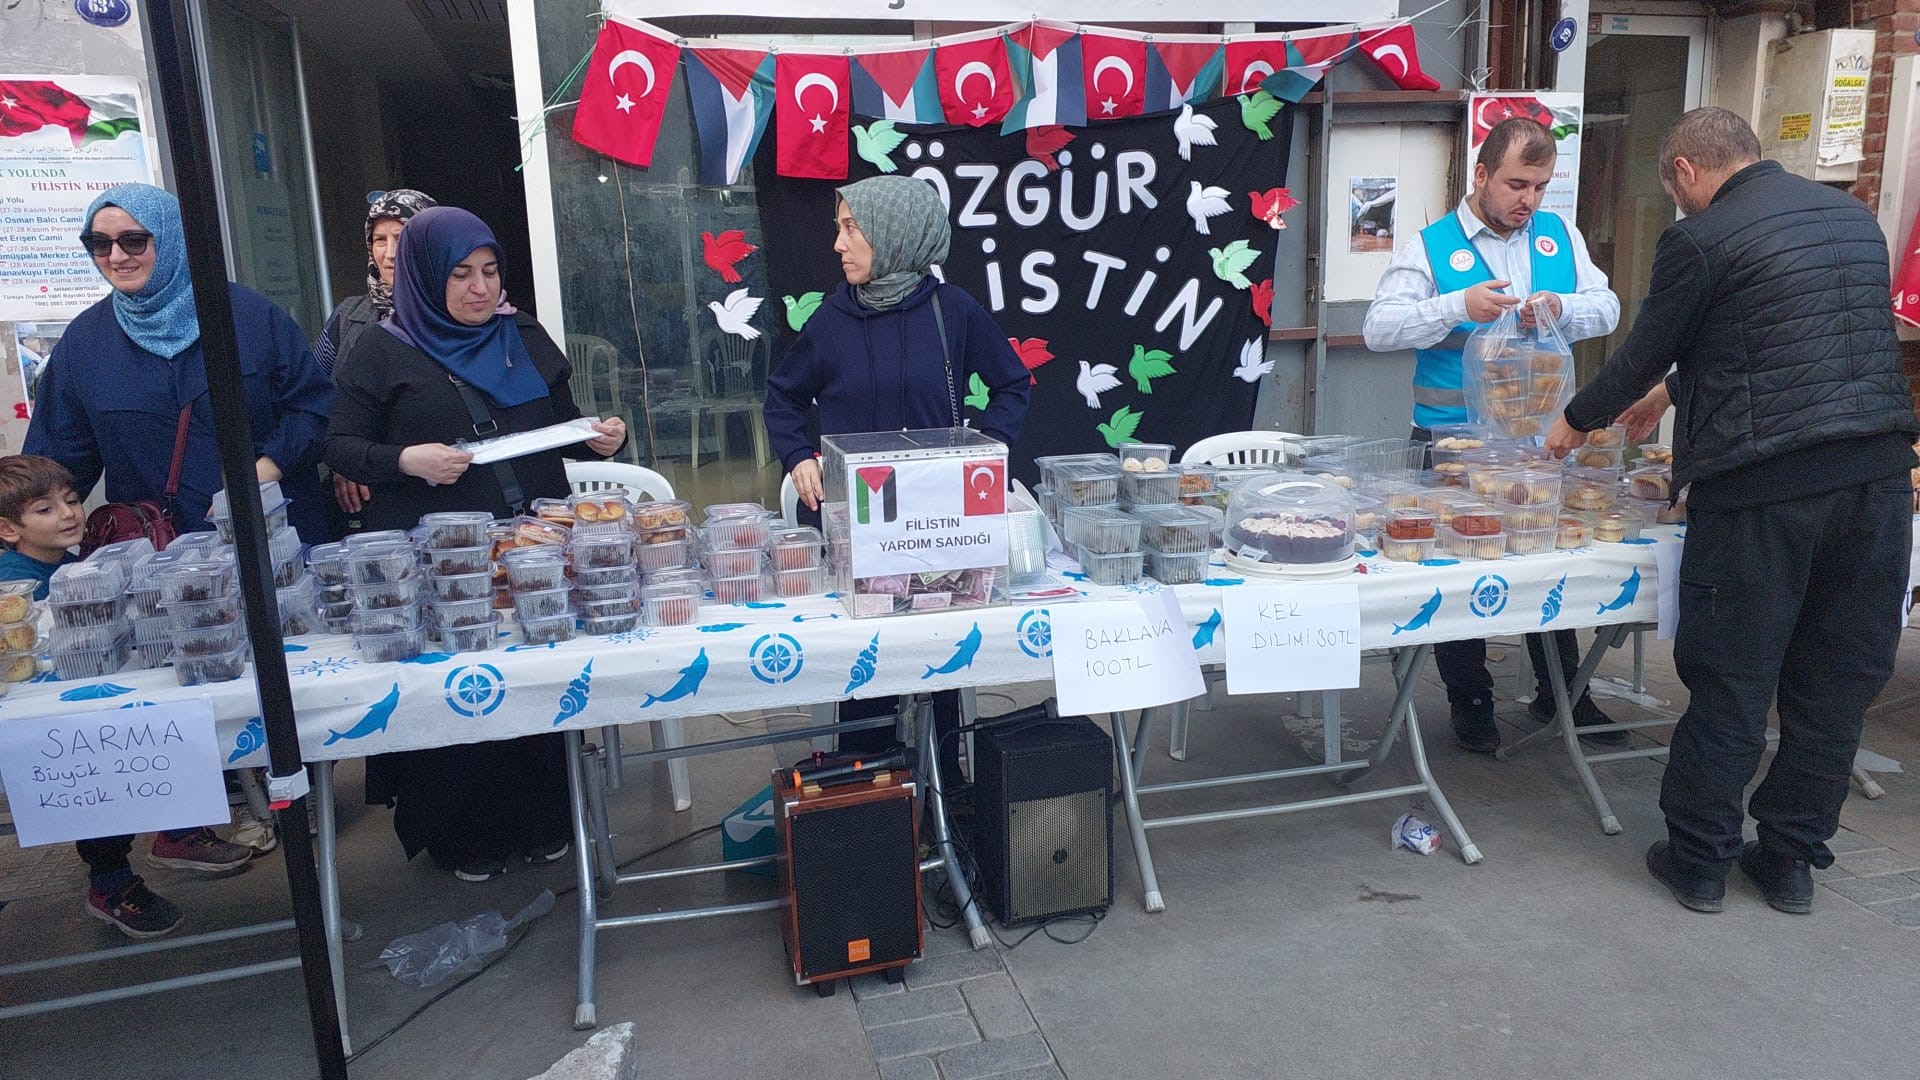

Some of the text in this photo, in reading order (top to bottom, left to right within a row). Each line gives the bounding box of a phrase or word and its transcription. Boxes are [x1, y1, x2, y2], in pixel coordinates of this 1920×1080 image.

[8, 169, 67, 178] YOLUNDA
[31, 180, 81, 191] FİLİSTİN
[905, 143, 1158, 231] ÖZGÜR
[6, 196, 25, 204] Yolu
[4, 216, 35, 224] Osman
[36, 216, 58, 224] Balcı
[60, 215, 84, 223] Camii
[10, 234, 37, 243] Erişen
[40, 251, 70, 259] Merkez
[44, 268, 65, 276] Fatih
[67, 267, 91, 275] Camii
[929, 237, 1223, 351] İSTİN
[905, 517, 960, 531] FİLİSTİN
[879, 532, 991, 552] YARDIM SANDIĞI
[1257, 602, 1304, 623] KEK
[1084, 617, 1174, 651] BAKLAVA
[1086, 656, 1152, 678] 100TL
[41, 719, 184, 760] SARMA
[32, 755, 171, 788] Büyük 200
[125, 781, 173, 798] 100
